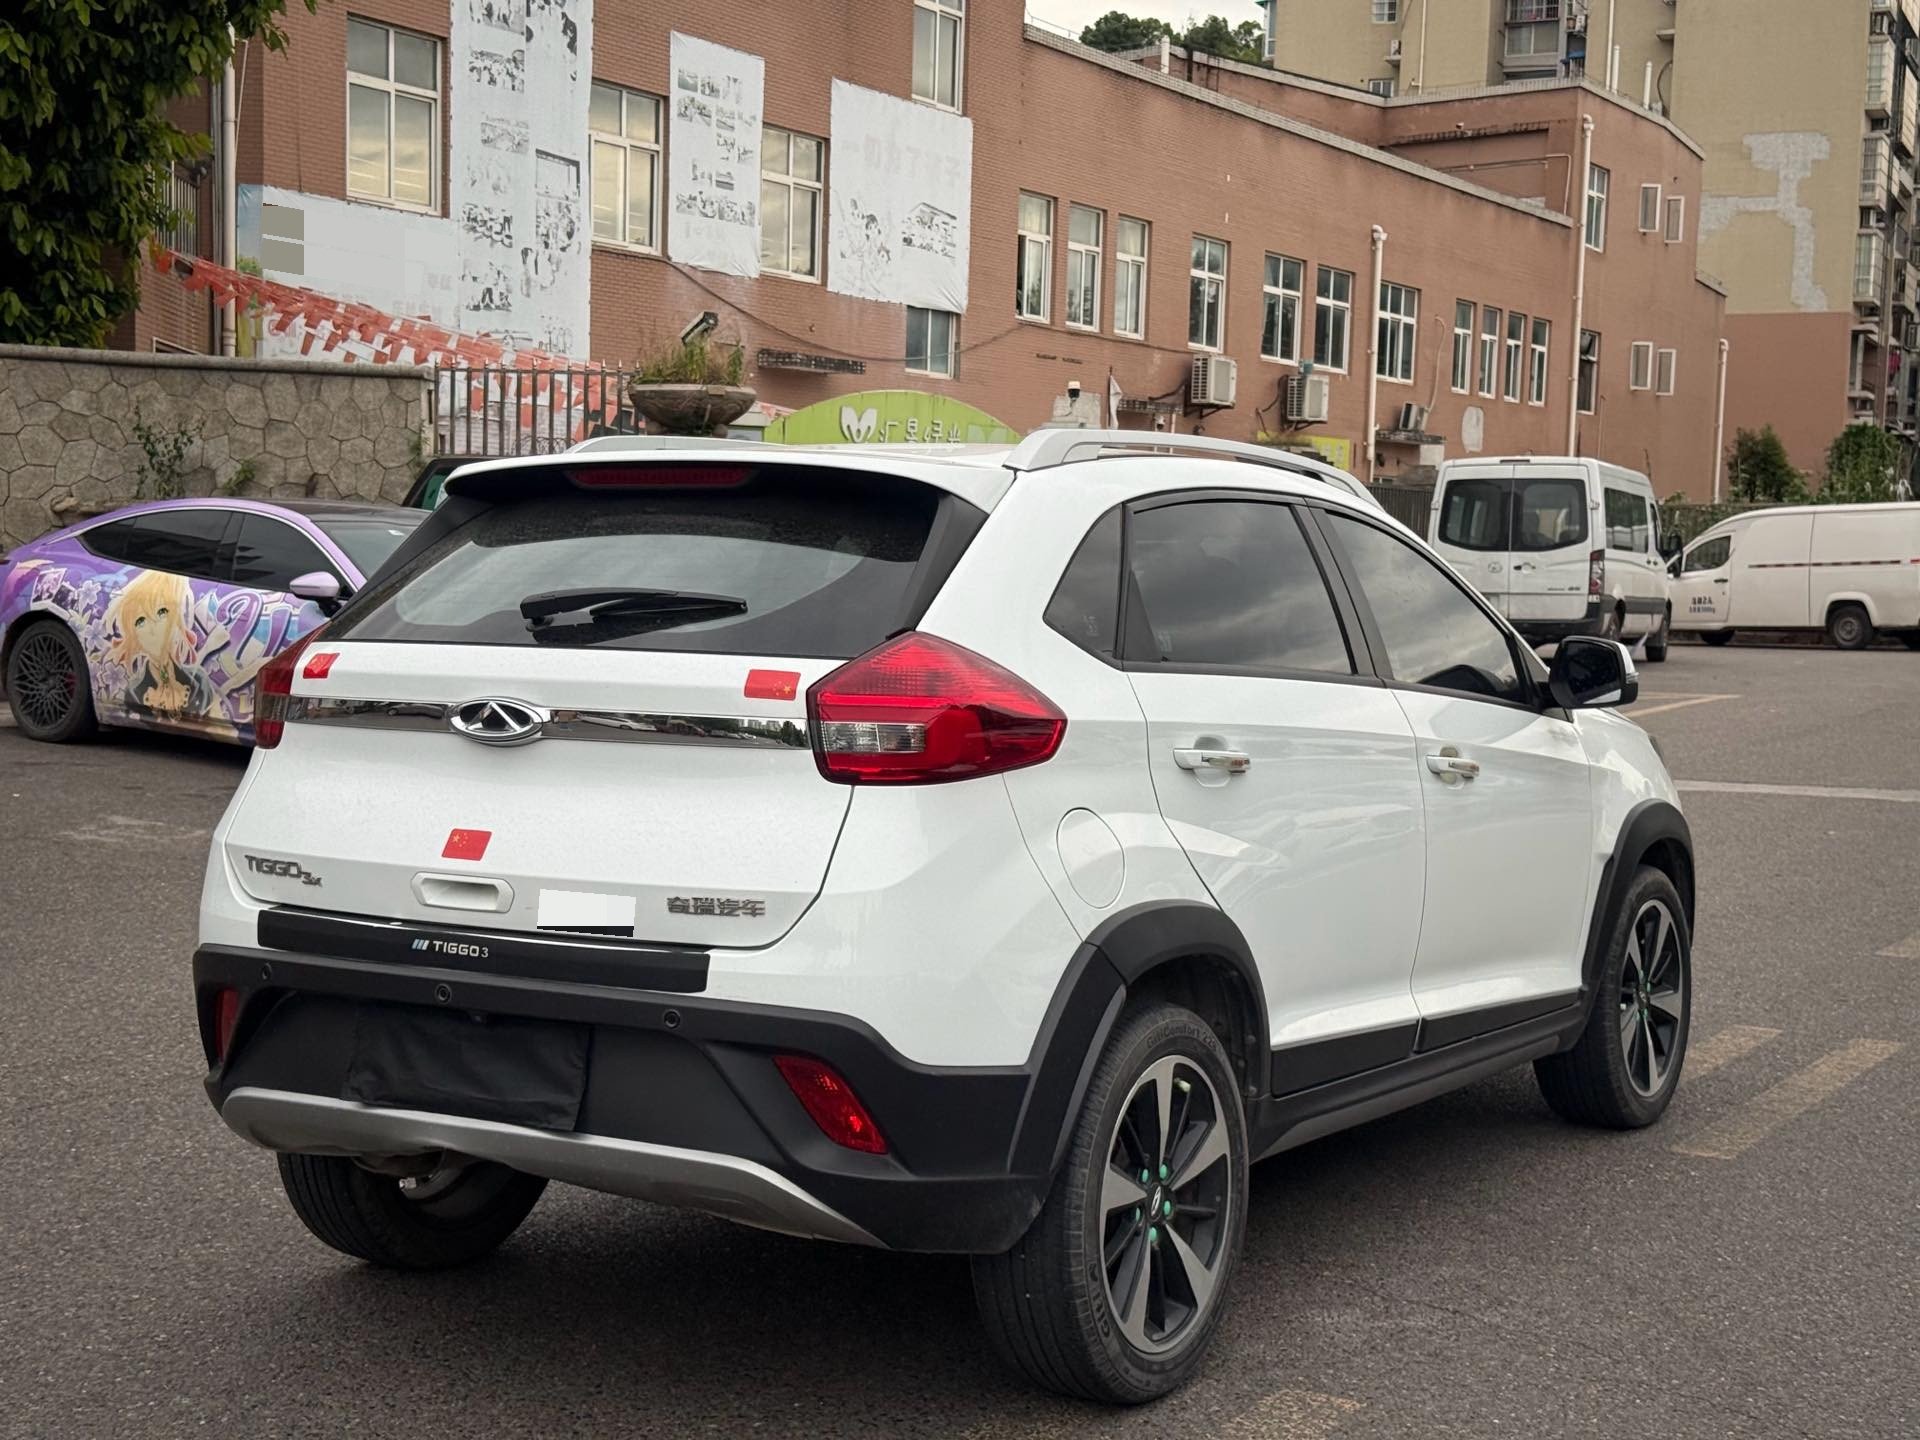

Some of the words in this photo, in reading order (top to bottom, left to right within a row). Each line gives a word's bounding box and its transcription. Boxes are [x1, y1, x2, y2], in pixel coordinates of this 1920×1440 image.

[244, 855, 302, 878] TIGGO
[666, 896, 766, 917] 奇瑞汽车
[433, 940, 480, 957] TIGGO
[480, 946, 490, 958] 3
